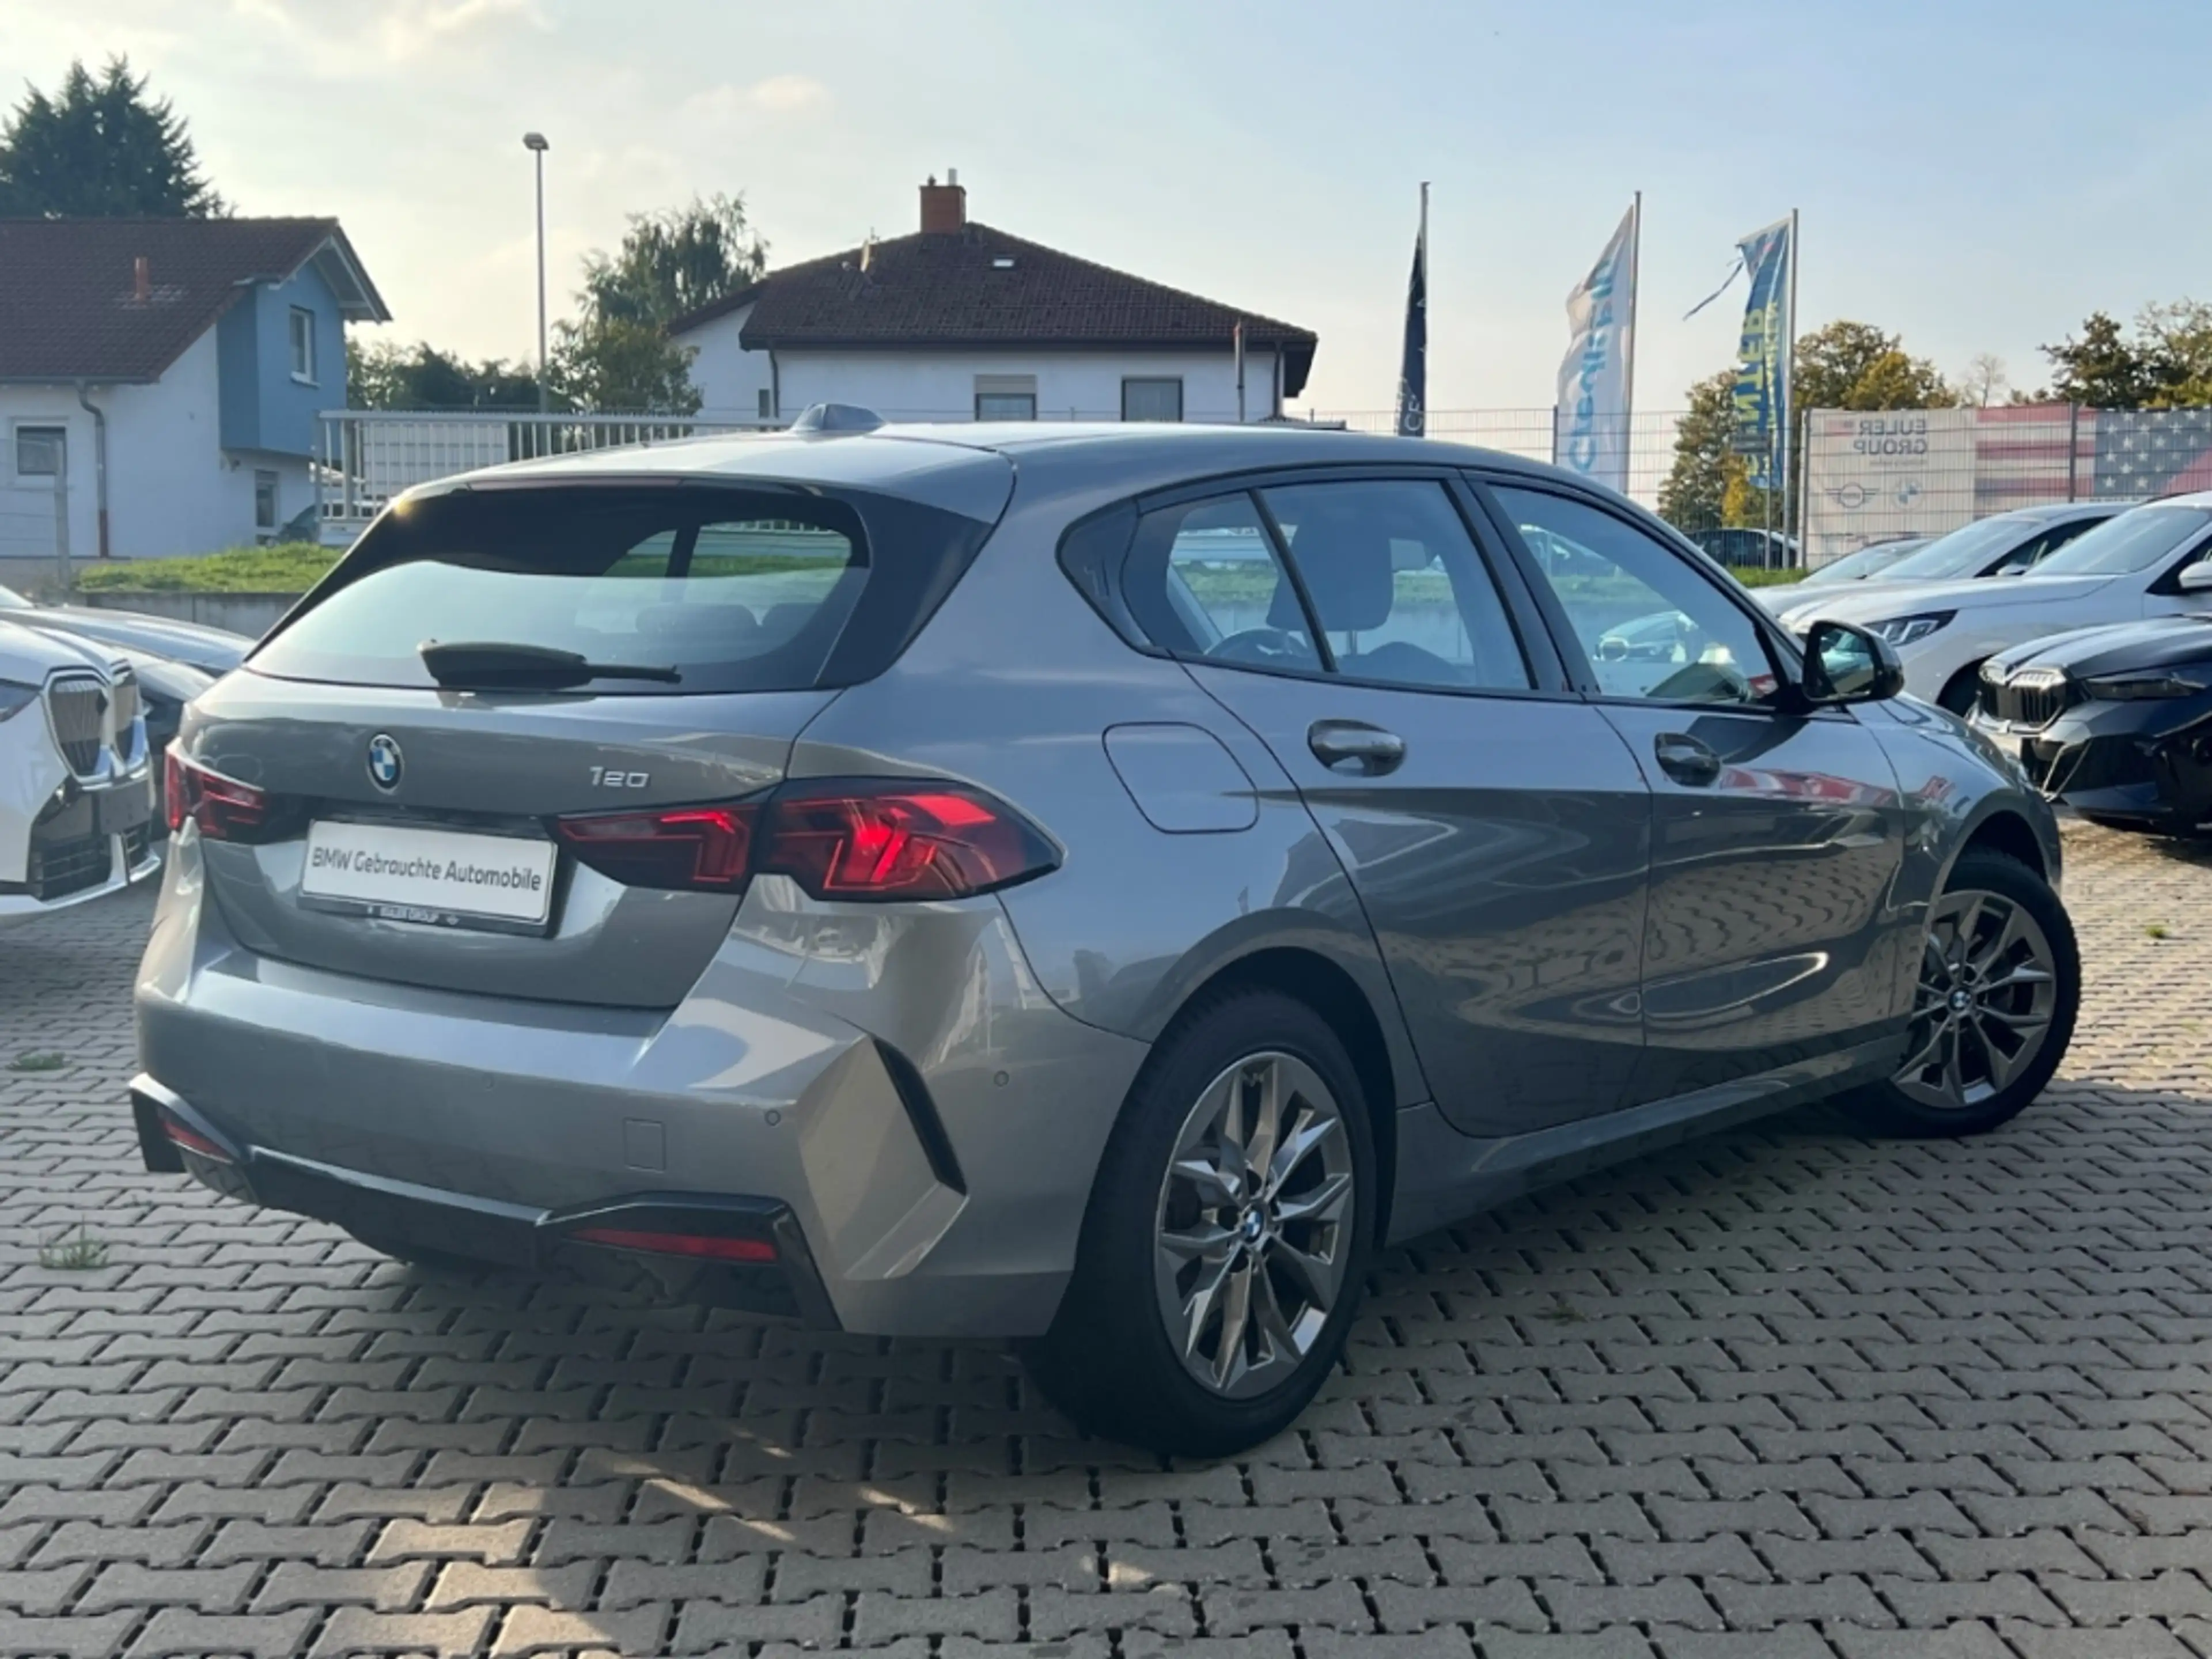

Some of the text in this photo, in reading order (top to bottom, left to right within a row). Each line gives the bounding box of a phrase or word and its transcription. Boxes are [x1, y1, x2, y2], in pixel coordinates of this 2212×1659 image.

[589, 766, 649, 788] 120
[312, 846, 541, 891] BMW Gebrauchte Automobile
